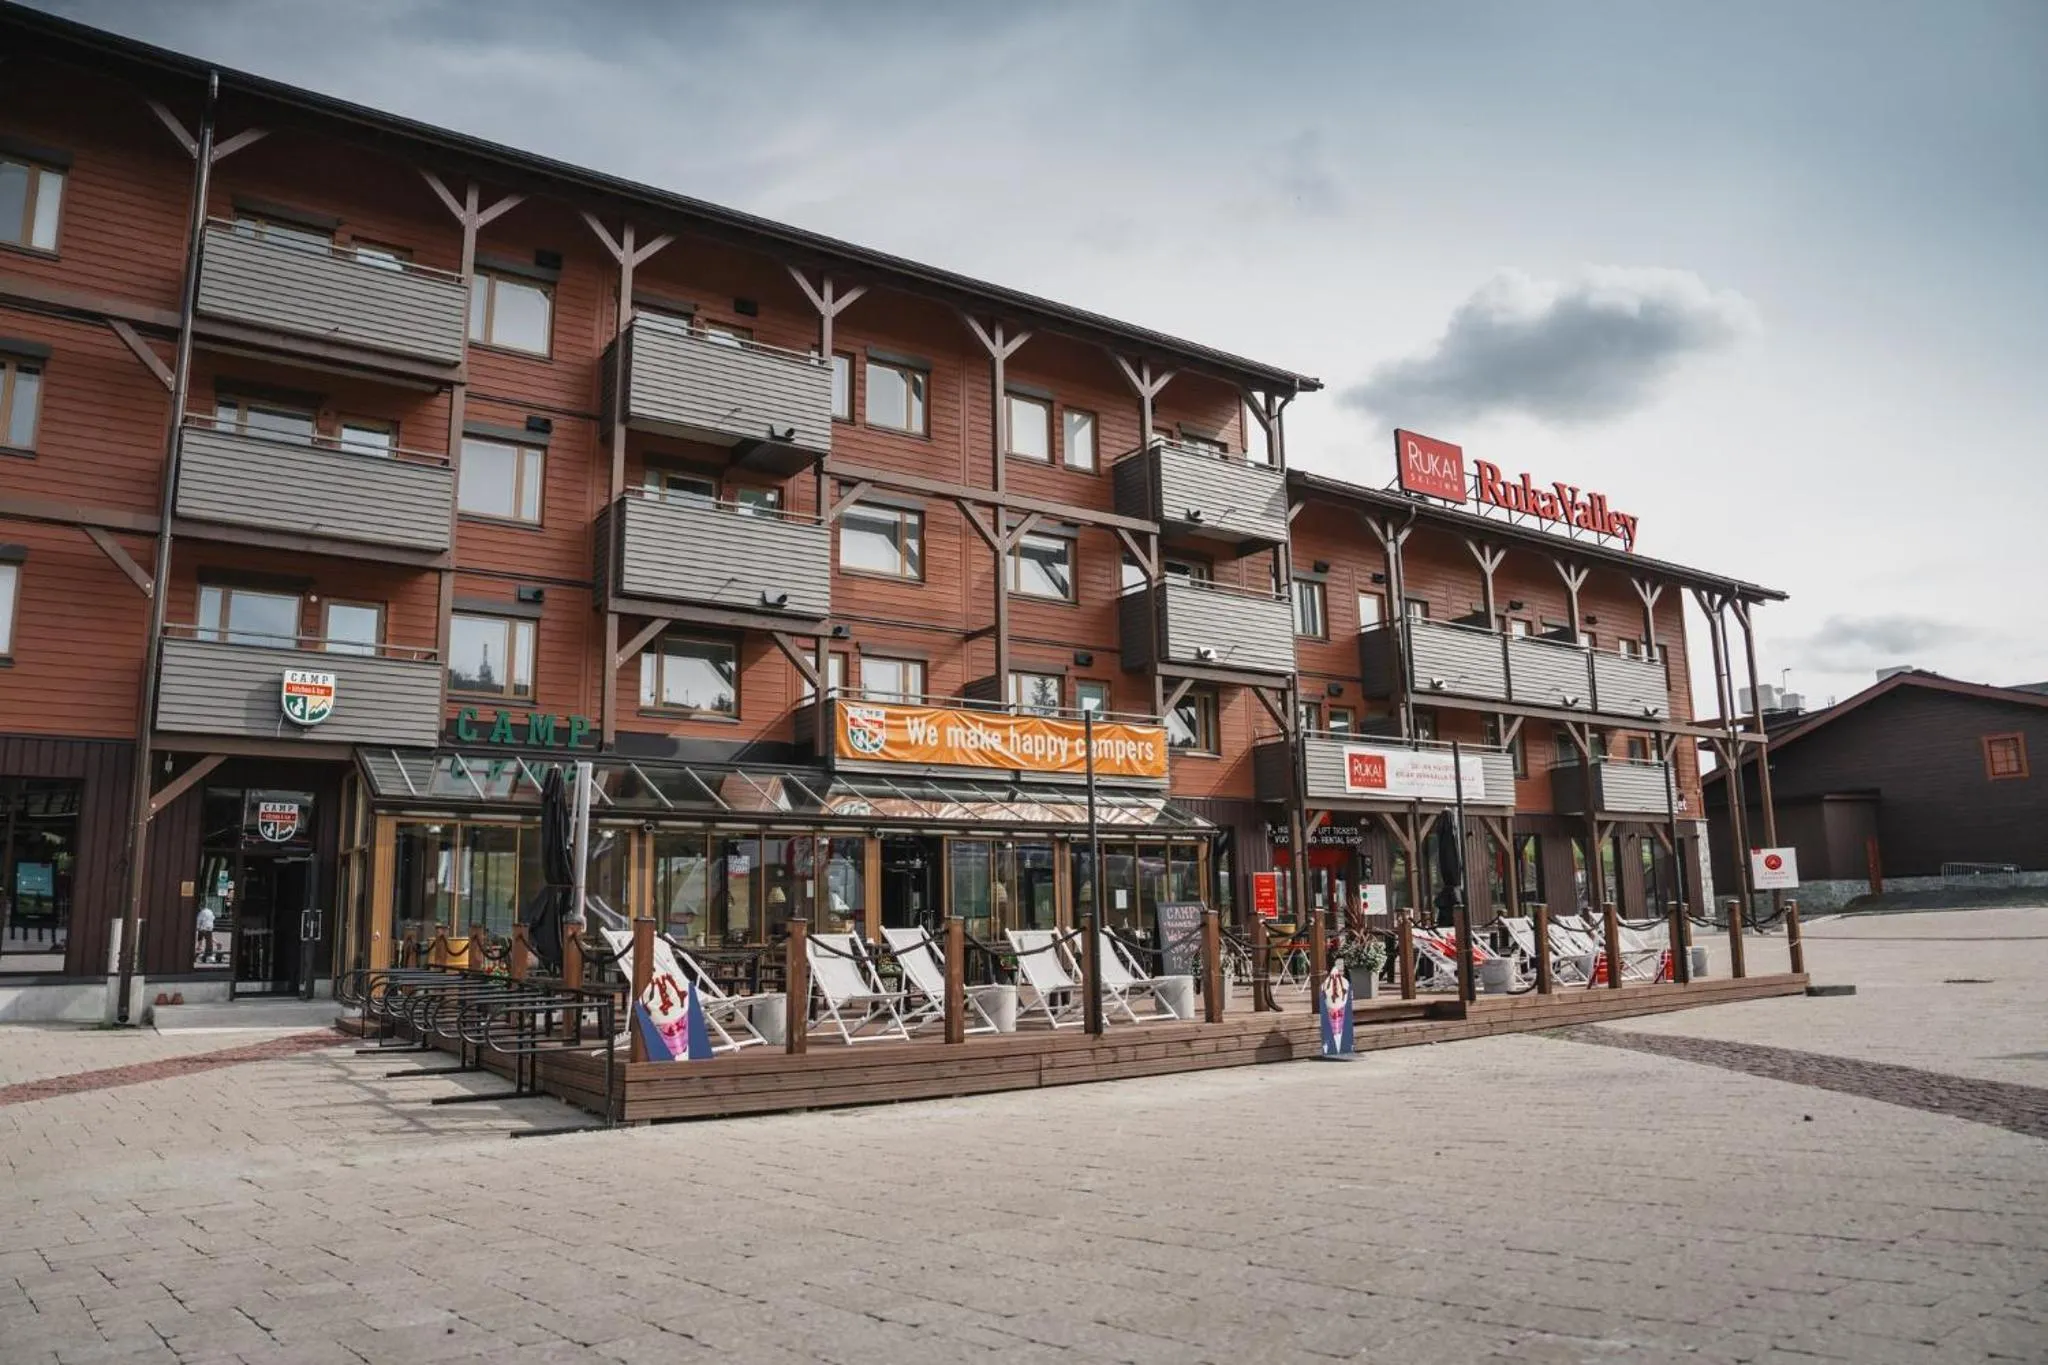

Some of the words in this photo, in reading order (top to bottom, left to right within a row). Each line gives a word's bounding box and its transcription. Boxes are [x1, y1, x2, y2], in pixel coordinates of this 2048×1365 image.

[1408, 440, 1458, 481] RUKA!
[1474, 459, 1639, 553] RukaValley
[290, 672, 329, 684] CAMP
[456, 706, 591, 748] CAMP
[905, 715, 938, 746] We
[946, 721, 1001, 752] make
[1009, 725, 1069, 763] happy
[264, 803, 295, 812] CAMP
